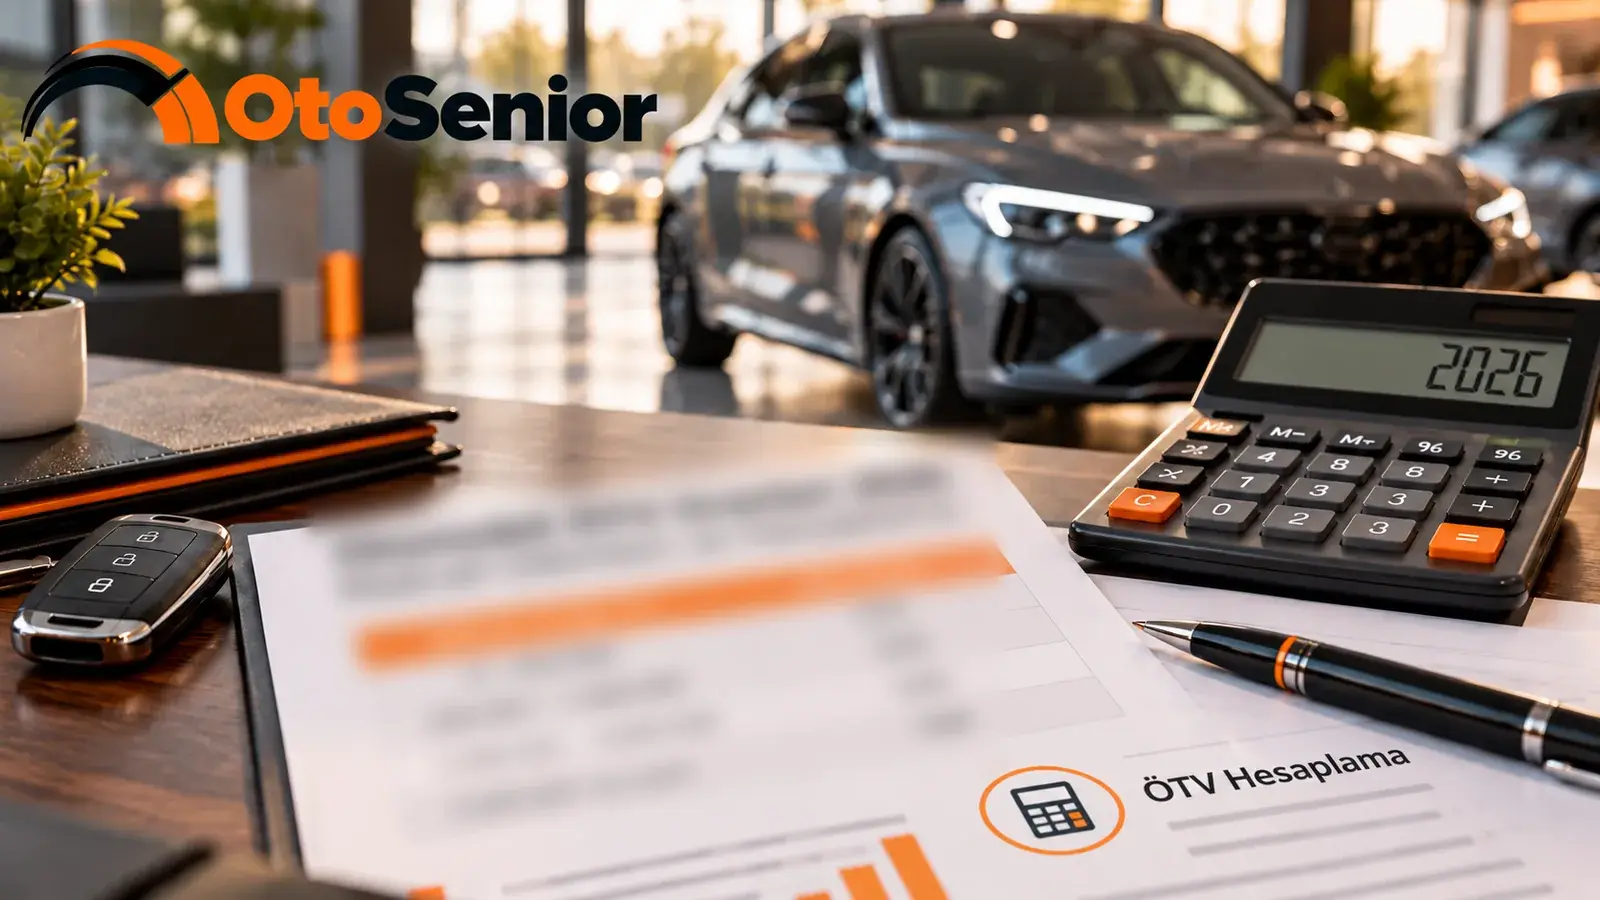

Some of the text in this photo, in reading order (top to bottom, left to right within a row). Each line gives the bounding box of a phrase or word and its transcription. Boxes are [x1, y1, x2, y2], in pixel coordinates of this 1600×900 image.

[1425, 343, 1549, 399] 2026
[1417, 441, 1443, 453] 96
[1257, 451, 1276, 464] 4
[1494, 449, 1521, 461] 96
[1330, 458, 1350, 471] 8
[1405, 466, 1425, 478] 8
[1240, 476, 1255, 489] 1
[1309, 484, 1329, 497] 3
[1134, 494, 1157, 507] C
[1387, 493, 1407, 506] 3
[1211, 503, 1232, 516] 0
[1288, 512, 1310, 526] 2
[1368, 521, 1390, 535] 3
[1142, 748, 1412, 803] ÖTV Hesaplama
